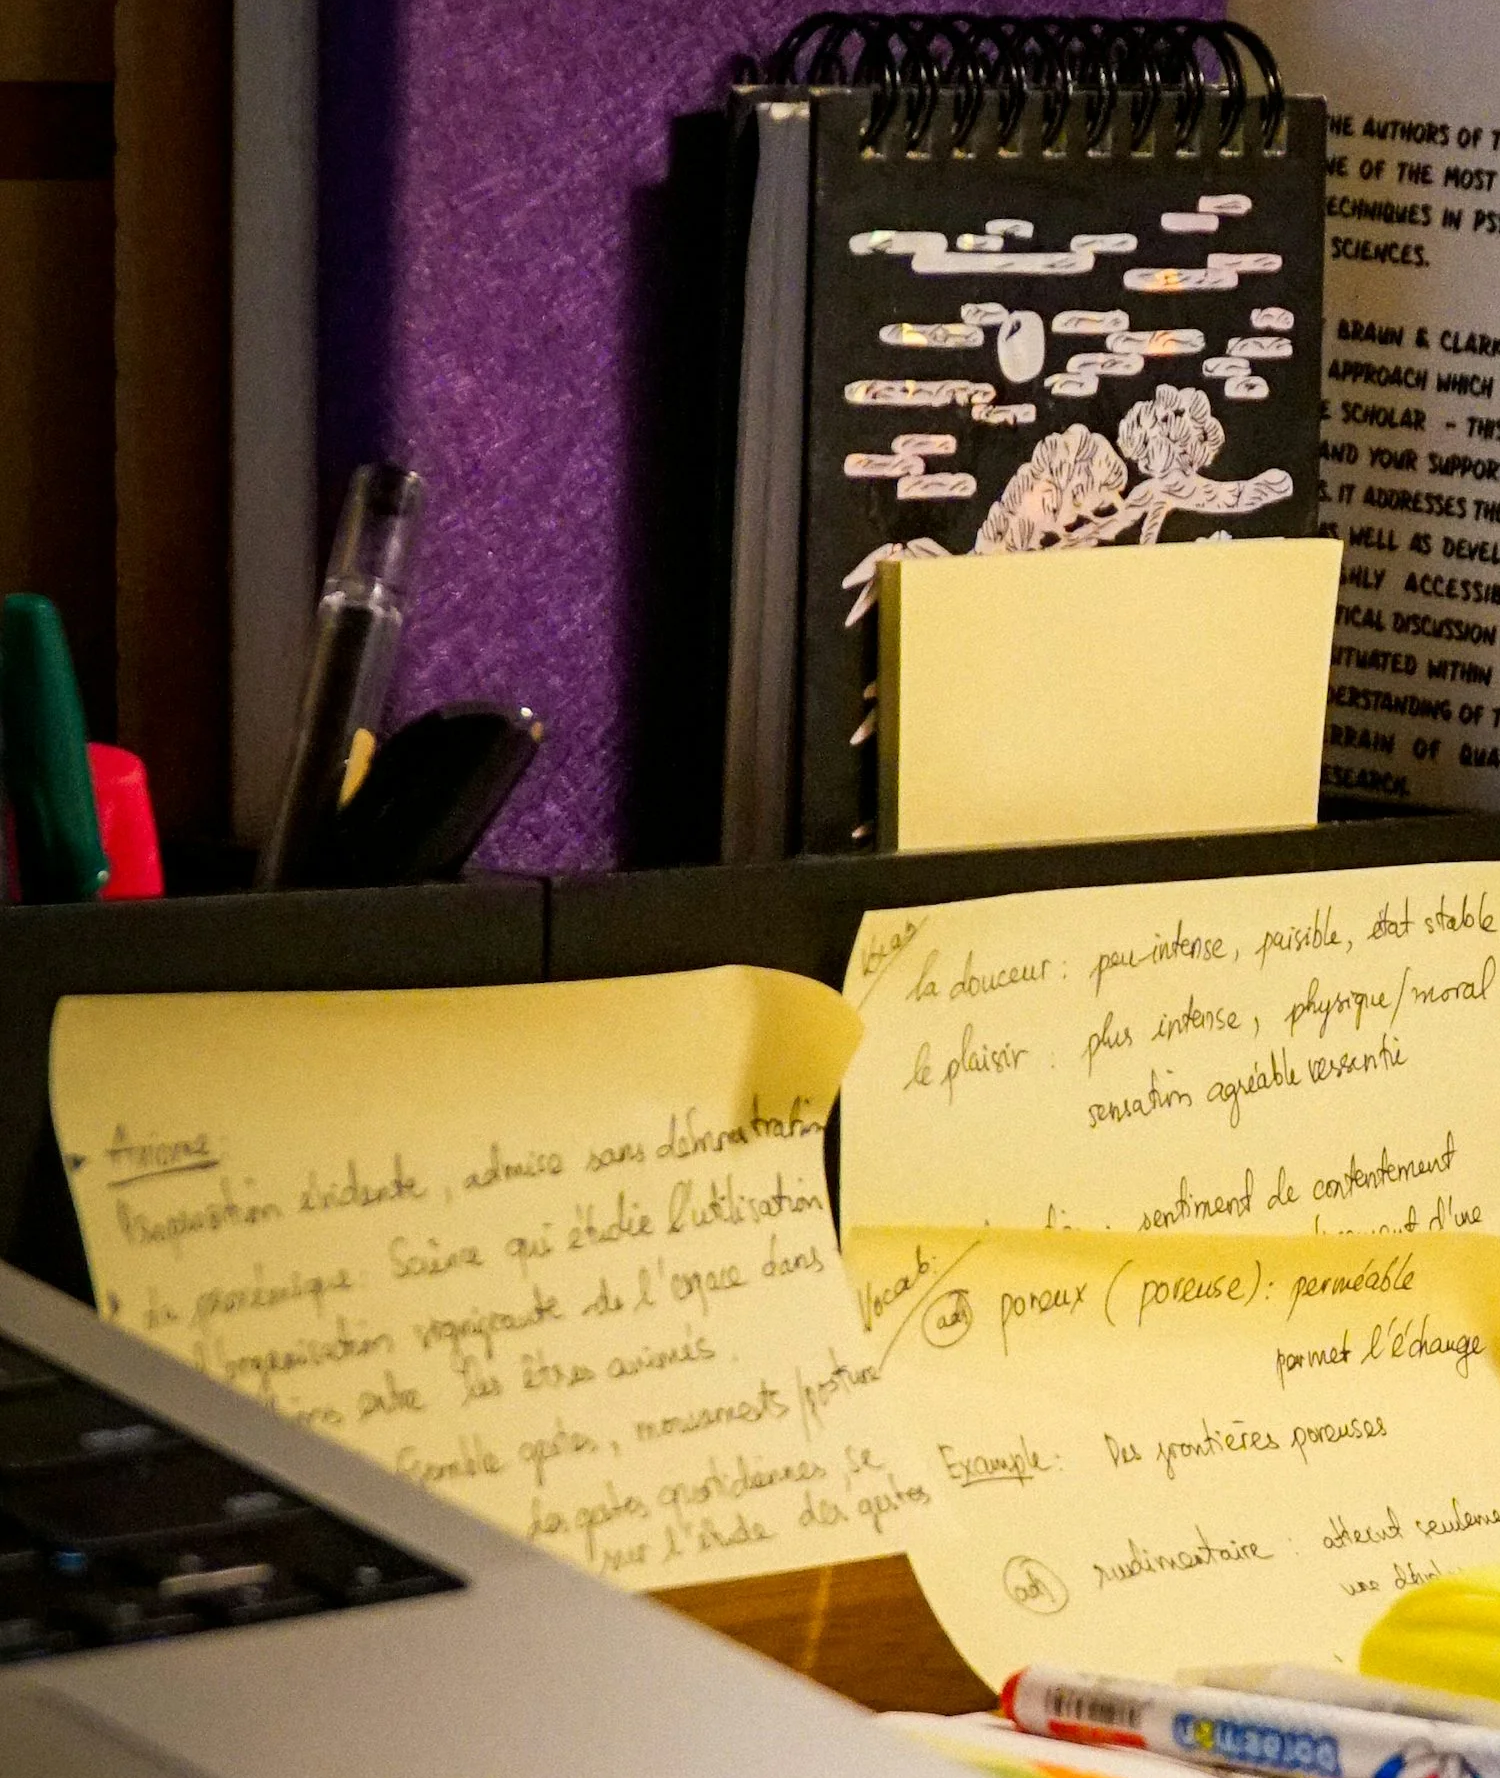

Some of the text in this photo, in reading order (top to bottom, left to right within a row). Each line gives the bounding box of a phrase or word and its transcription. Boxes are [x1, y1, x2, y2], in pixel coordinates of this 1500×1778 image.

[1363, 117, 1449, 146] AUTHORS
[1457, 127, 1483, 149] OF
[1359, 159, 1385, 180] OF
[1398, 162, 1433, 185] THE
[1443, 166, 1497, 191] MOST
[1442, 208, 1462, 230] IN
[1331, 236, 1429, 267] SCIENCES.
[1337, 319, 1403, 347] BRAUN
[1415, 327, 1429, 349] &
[1328, 359, 1427, 390] APPROACH
[1436, 373, 1493, 399] WHICH
[1341, 401, 1426, 431] SCHOLAR
[1369, 447, 1418, 471] YOUR
[1338, 484, 1356, 505] IT
[1363, 486, 1466, 519] ADDRESSES
[1349, 527, 1398, 552] WELL
[1408, 532, 1431, 555] AS
[1392, 612, 1496, 645] DISCUSSION
[1427, 659, 1492, 686] WITHIN
[1458, 703, 1484, 726] OF
[1412, 737, 1441, 761] OF
[905, 949, 939, 1001] la
[950, 950, 1050, 1000] douceur
[1425, 891, 1498, 934] stable
[904, 1011, 1134, 1107] le plaisir plus
[1207, 1047, 1300, 1128] agréable
[1267, 1166, 1299, 1209] de
[1000, 1283, 1087, 1357] poreux
[1286, 1252, 1414, 1322] perméable
